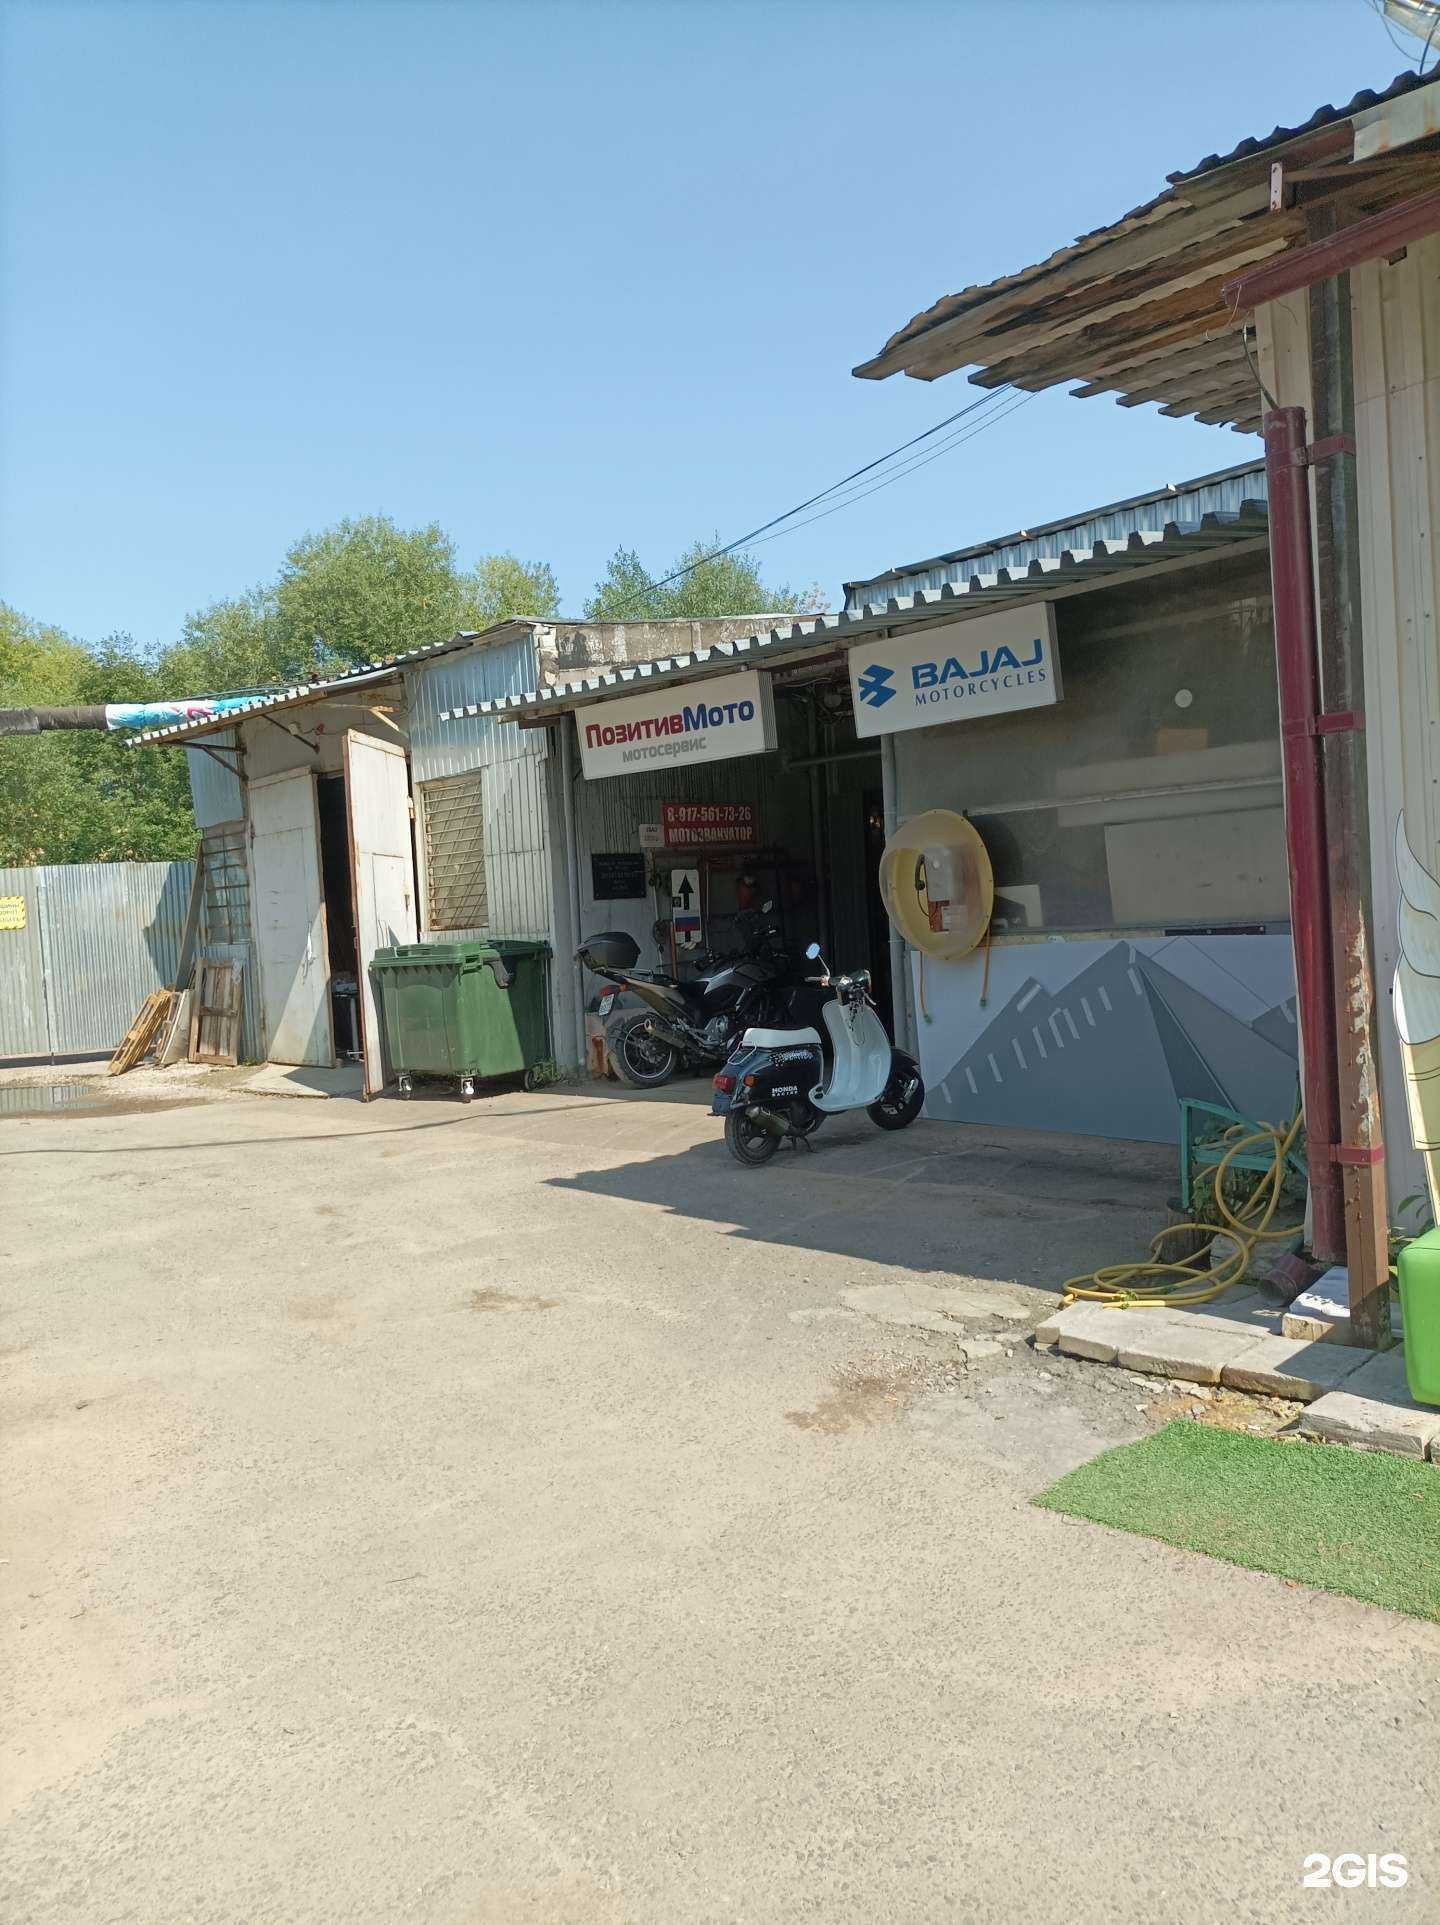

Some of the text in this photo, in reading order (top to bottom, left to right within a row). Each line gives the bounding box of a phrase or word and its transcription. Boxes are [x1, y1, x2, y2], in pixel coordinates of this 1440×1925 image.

[911, 638, 1043, 690] BAJAJ
[914, 668, 1047, 706] MOTORCYCLES
[622, 737, 707, 763] мотосервис
[667, 806, 752, 822] 8-917-561-73-26
[771, 1085, 798, 1094] HONDA
